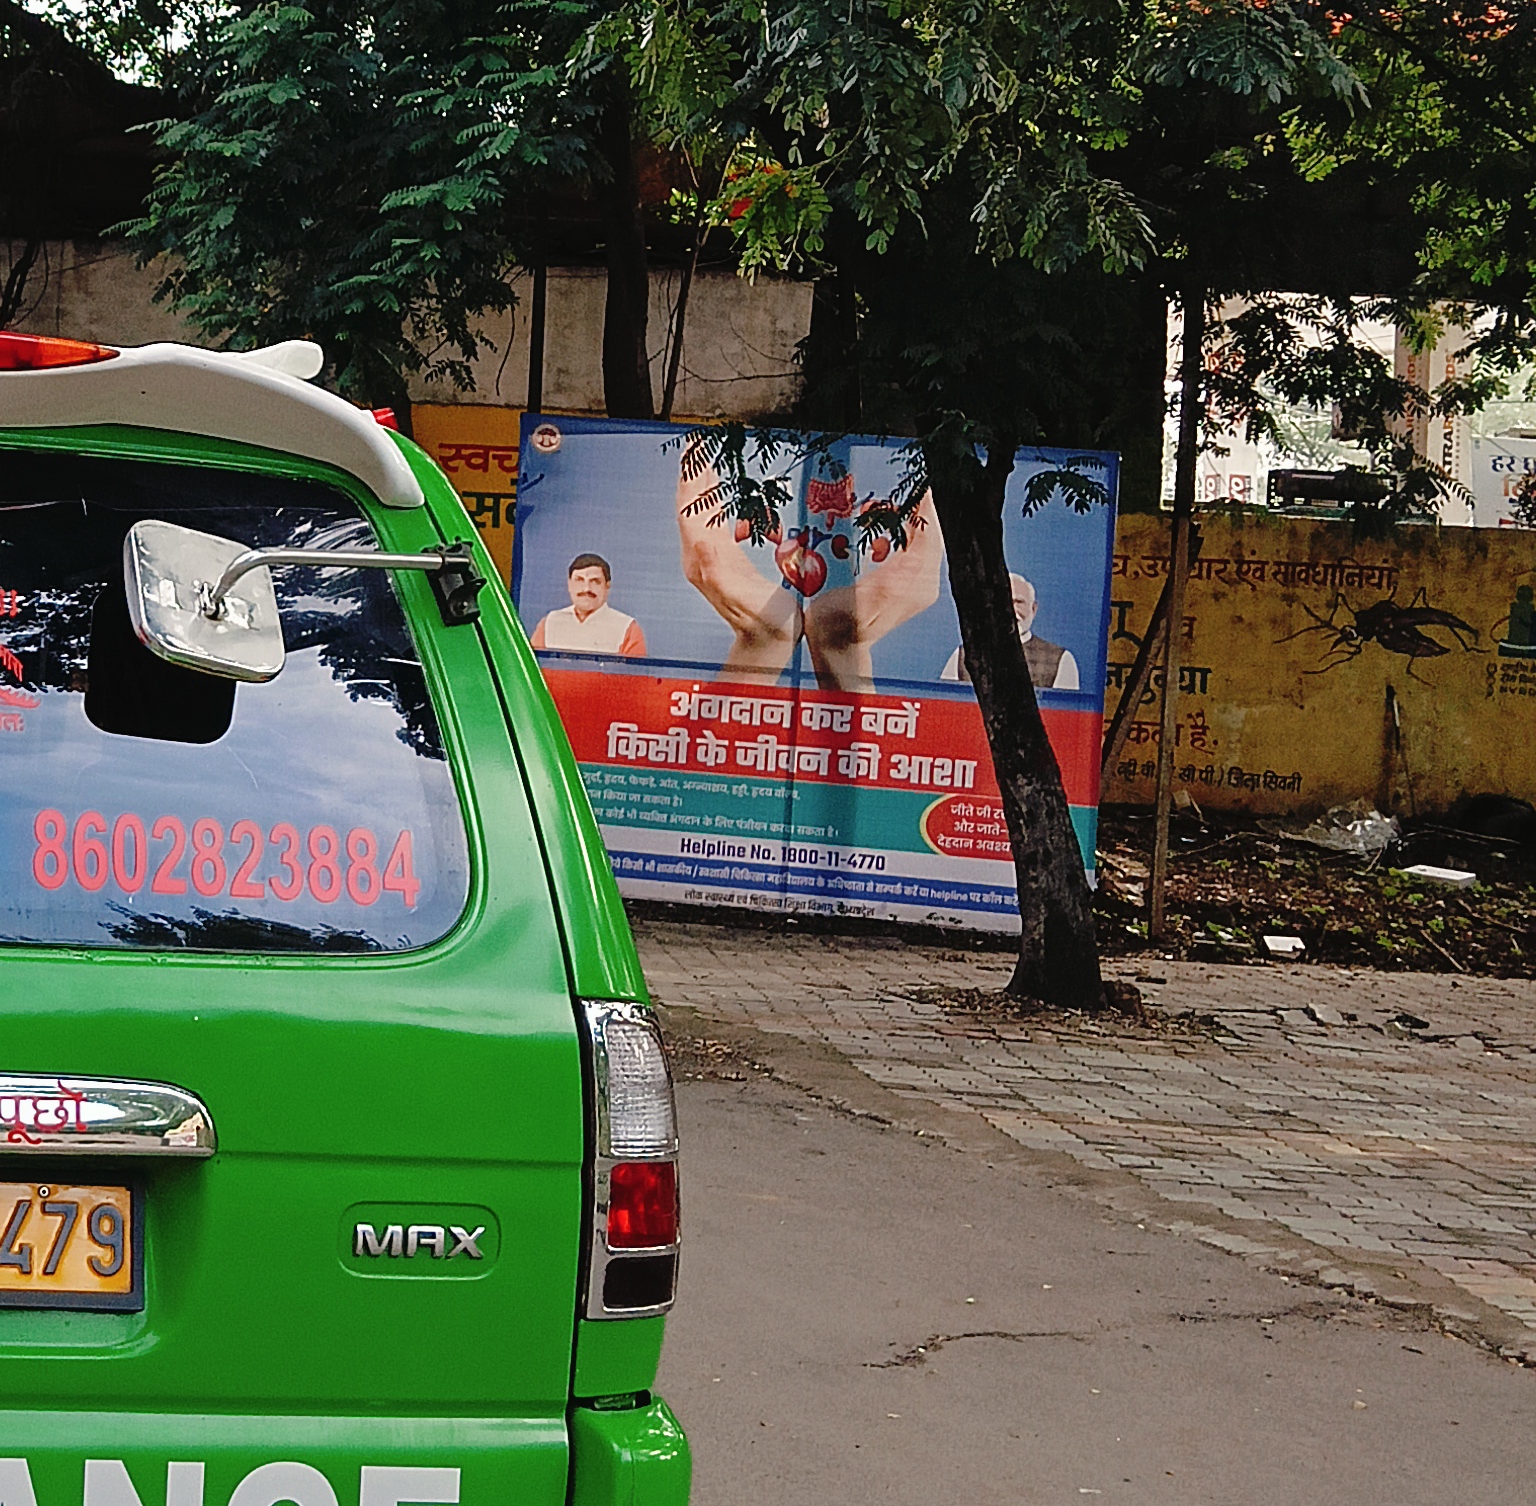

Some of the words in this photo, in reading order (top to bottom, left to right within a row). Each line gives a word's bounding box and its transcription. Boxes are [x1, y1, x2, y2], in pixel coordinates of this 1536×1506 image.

[670, 684, 794, 728] अंगदान
[801, 702, 854, 733] कर
[860, 701, 920, 738] बनें
[607, 722, 690, 764] किसी
[696, 730, 729, 766] के
[735, 734, 831, 776] जीवन
[838, 742, 881, 780] की
[890, 754, 977, 788] आशा
[951, 803, 974, 817] जीते
[976, 805, 990, 819] जी
[33, 808, 420, 906] 8602823884
[681, 838, 745, 861] Helpline
[751, 844, 775, 861] No.
[781, 846, 886, 871] 1800-11-4770
[930, 889, 968, 903] helpline
[354, 1223, 485, 1259] MAX
